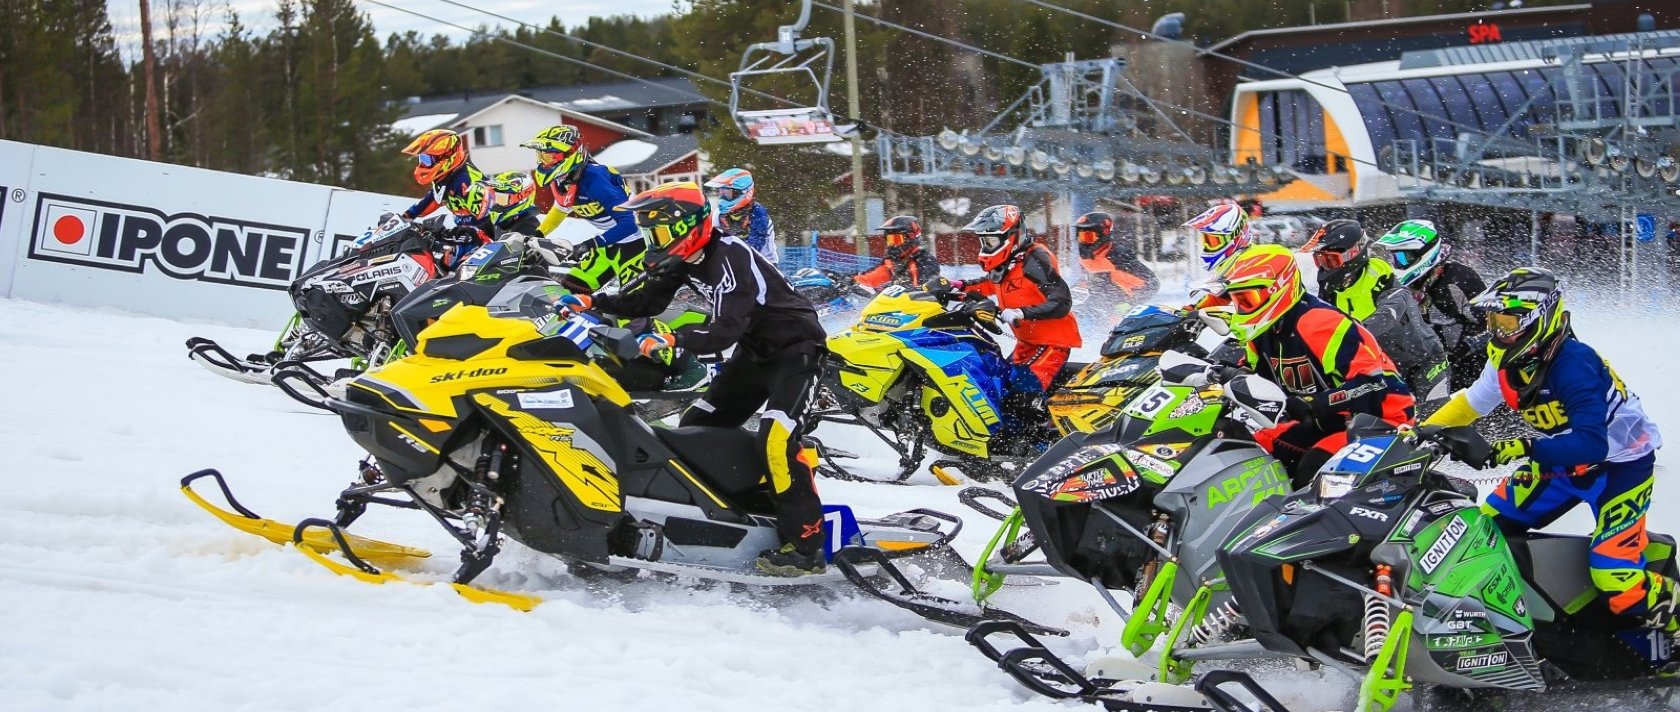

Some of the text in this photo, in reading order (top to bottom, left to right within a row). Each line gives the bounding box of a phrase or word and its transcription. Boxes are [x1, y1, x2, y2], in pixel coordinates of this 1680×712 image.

[1468, 23, 1501, 43] SPA
[97, 212, 297, 281] IPONE
[356, 231, 372, 245] 2
[430, 367, 508, 384] ski-doo
[397, 433, 428, 453] RS
[1207, 460, 1289, 510] ARCTIC
[1349, 507, 1388, 522] FXR
[1423, 515, 1466, 570] IGNITION
[1447, 620, 1474, 629] GBT
[1459, 654, 1506, 668] IGNITION
